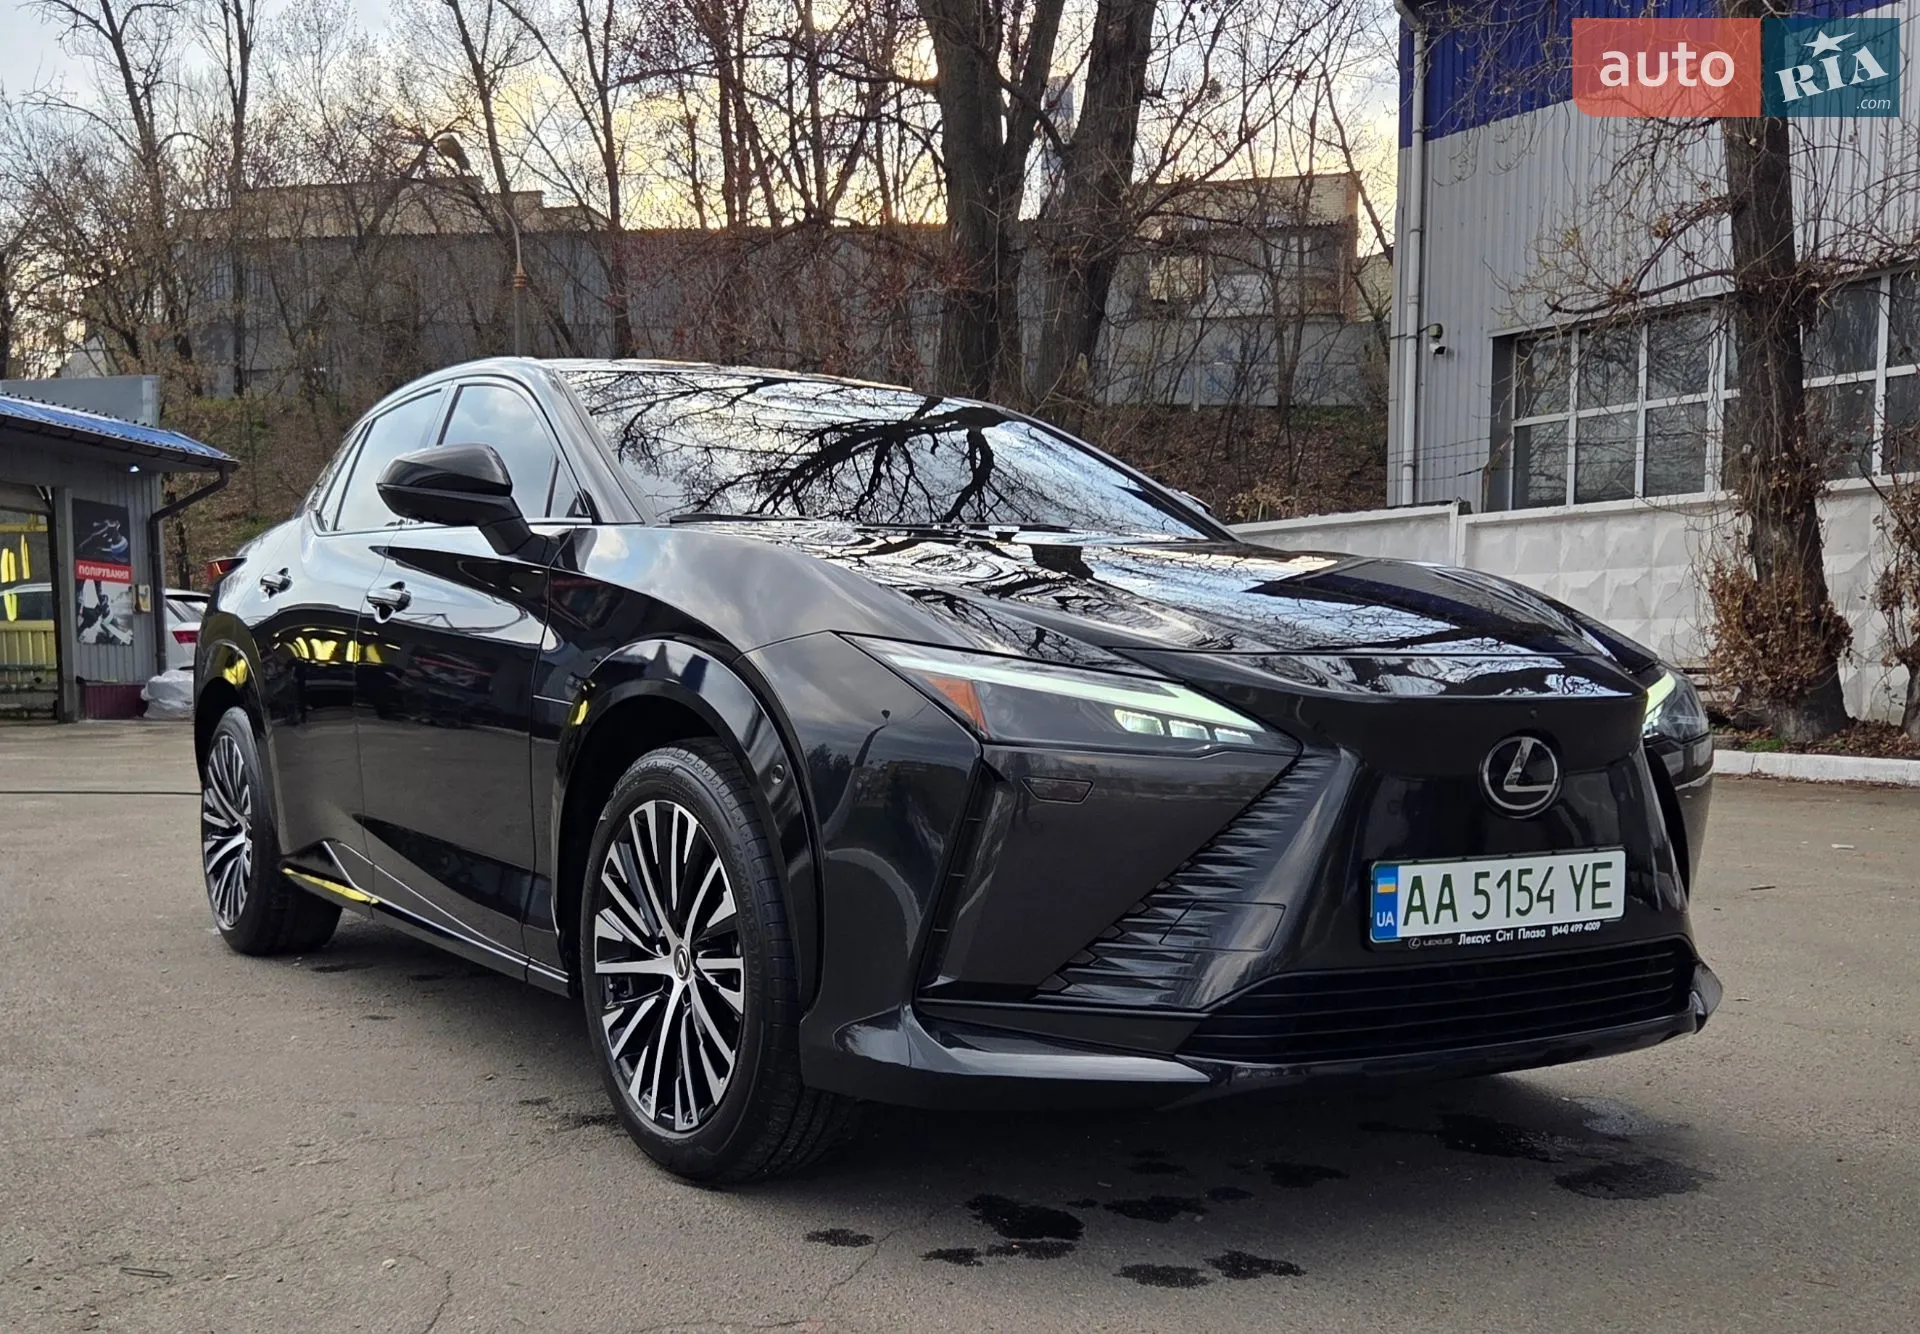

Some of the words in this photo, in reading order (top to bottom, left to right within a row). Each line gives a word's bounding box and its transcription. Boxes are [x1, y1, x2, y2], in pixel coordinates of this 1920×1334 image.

[1403, 873, 1458, 926] AA
[1472, 866, 1555, 920] 5154
[1569, 861, 1613, 912] YE
[1376, 911, 1395, 928] UA
[1458, 933, 1492, 946] Лексус
